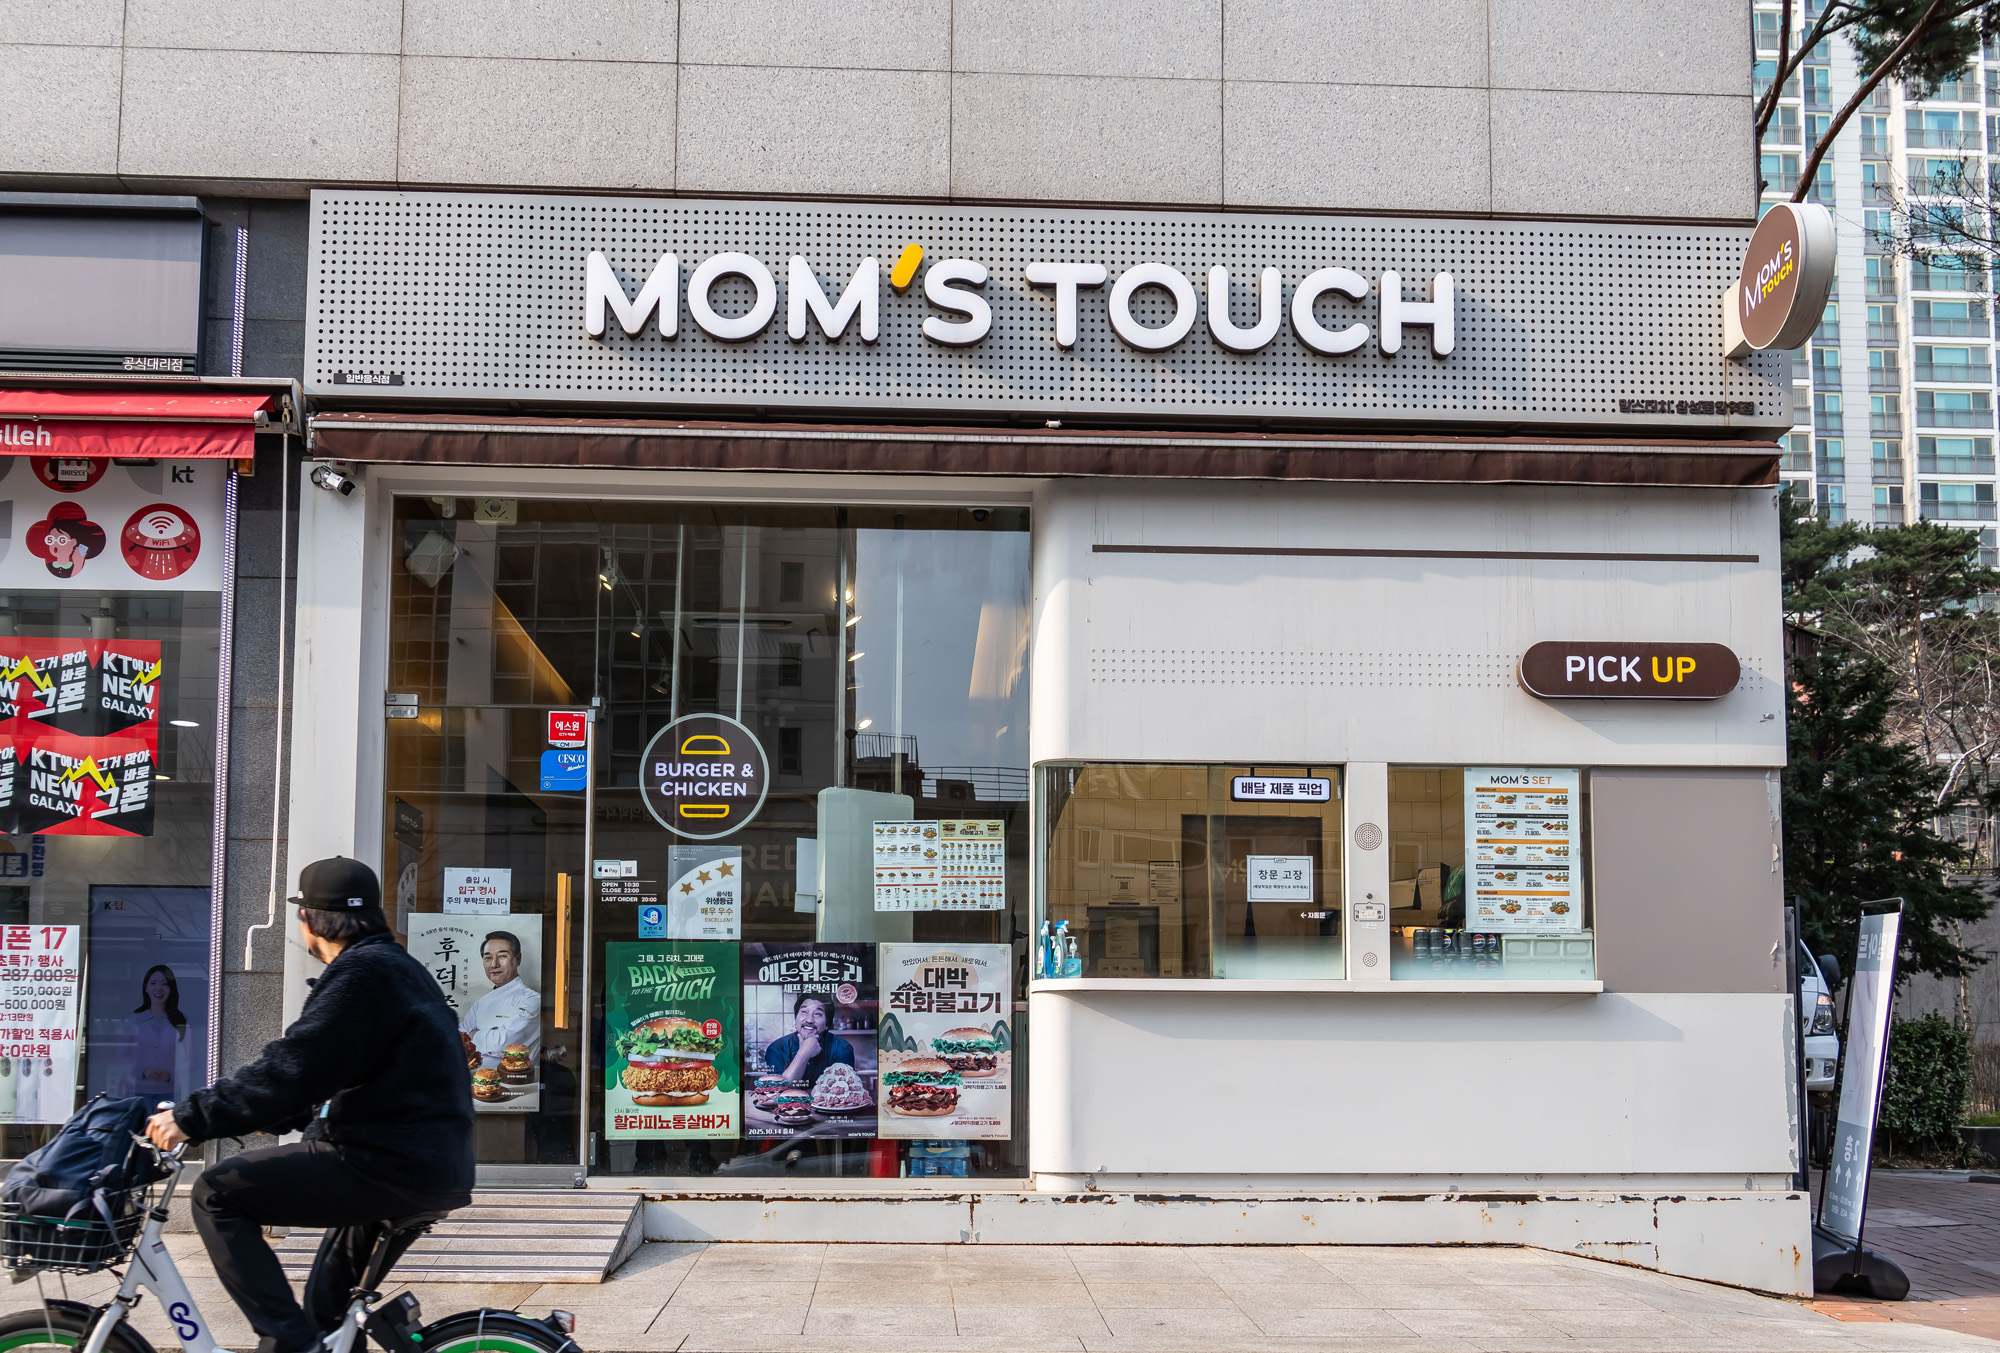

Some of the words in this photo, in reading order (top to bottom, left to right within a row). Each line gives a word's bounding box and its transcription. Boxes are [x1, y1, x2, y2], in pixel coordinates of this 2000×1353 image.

[1745, 240, 1792, 317] MOM'S
[1762, 259, 1793, 298] TOUCH
[585, 244, 992, 348] MOM'S
[1025, 262, 1455, 359] TOUCH
[122, 356, 184, 371] 공식대리점
[346, 374, 390, 384] 일반음식점
[1619, 399, 1671, 414] 맘스터치
[171, 466, 195, 484] kt
[151, 539, 170, 547] WiFi
[61, 666, 87, 682] 바로
[1566, 656, 1641, 683] PICK
[1652, 656, 1696, 683] UP
[103, 675, 155, 703] NEW
[101, 697, 155, 720] GALAXY
[555, 721, 579, 731] 에스원
[558, 753, 585, 763] CESCO
[123, 765, 150, 782] 바로
[655, 763, 735, 777] BURGER
[741, 763, 754, 777] &
[30, 769, 83, 800] NEW
[1490, 775, 1530, 785] MOM'S
[1532, 776, 1552, 785] SET
[660, 781, 747, 796] CHICKEN
[1241, 782, 1266, 795] 배달
[1269, 782, 1294, 795] 제품
[1298, 782, 1322, 796] 픽업
[29, 793, 83, 817] GALAXY
[1258, 870, 1278, 881] 창문
[1282, 870, 1303, 881] 고장
[458, 886, 476, 895] 입구
[479, 886, 496, 895] 경사
[463, 897, 508, 905] 부탁드립니다
[718, 907, 733, 915] 우수
[0, 926, 31, 950] 폰
[40, 927, 67, 949] 17
[38, 955, 63, 967] 행사
[627, 965, 678, 987] BACK
[924, 967, 969, 989] 대박
[640, 986, 654, 994] THE
[654, 976, 716, 1002] TOUCH
[890, 991, 1001, 1014] 직화불고기
[39, 1029, 75, 1040] 적용시
[614, 1115, 729, 1130] 할라피뇨통살버거
